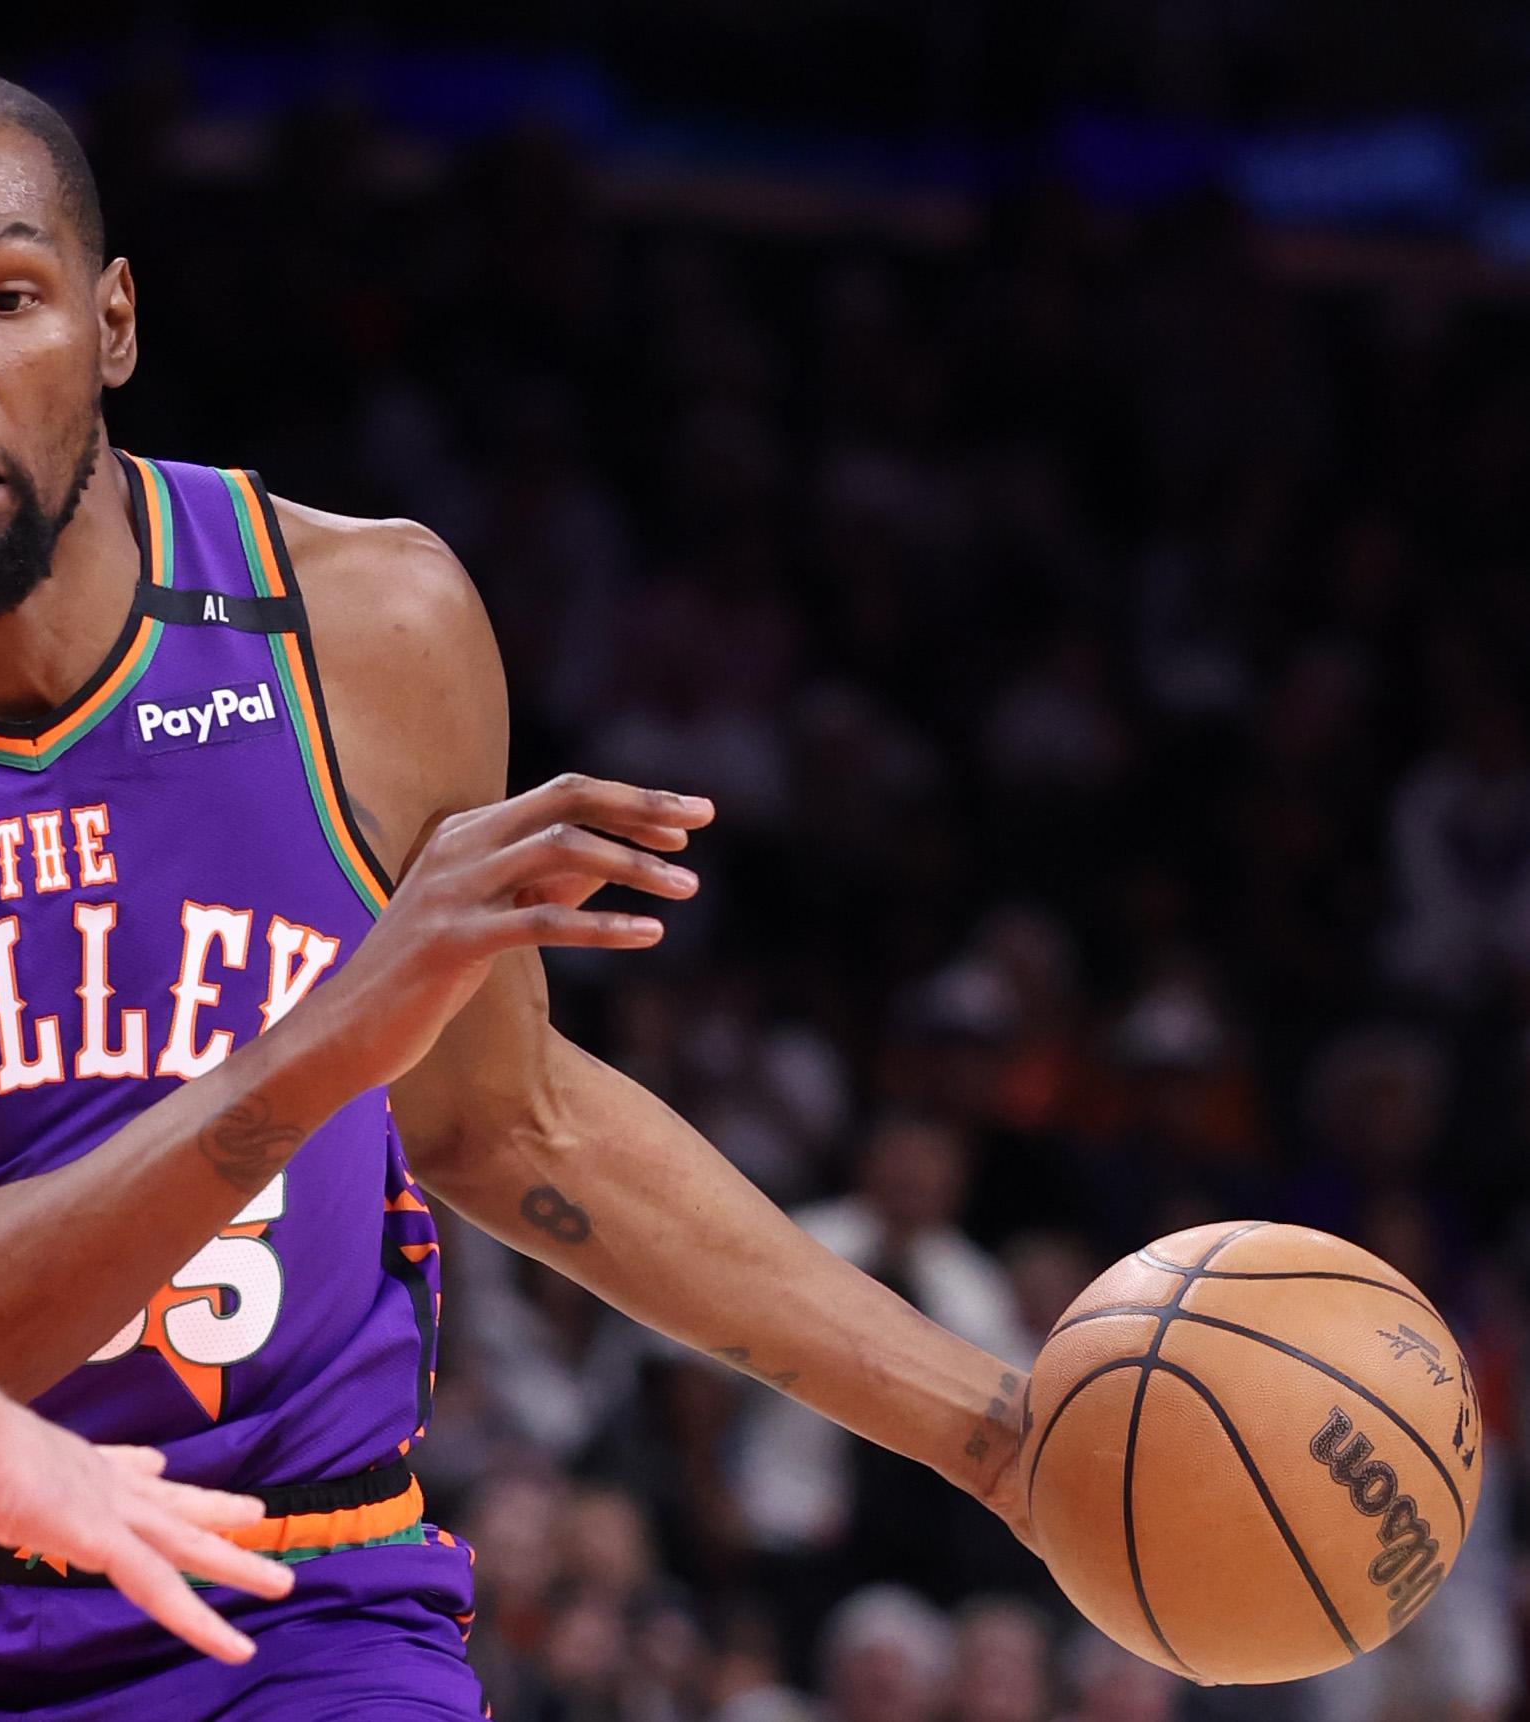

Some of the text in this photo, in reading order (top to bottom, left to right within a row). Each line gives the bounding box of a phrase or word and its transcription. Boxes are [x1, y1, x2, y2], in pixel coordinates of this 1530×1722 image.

[203, 594, 230, 623] AL
[137, 682, 276, 743] PayPal
[84, 1168, 286, 1367] 5
